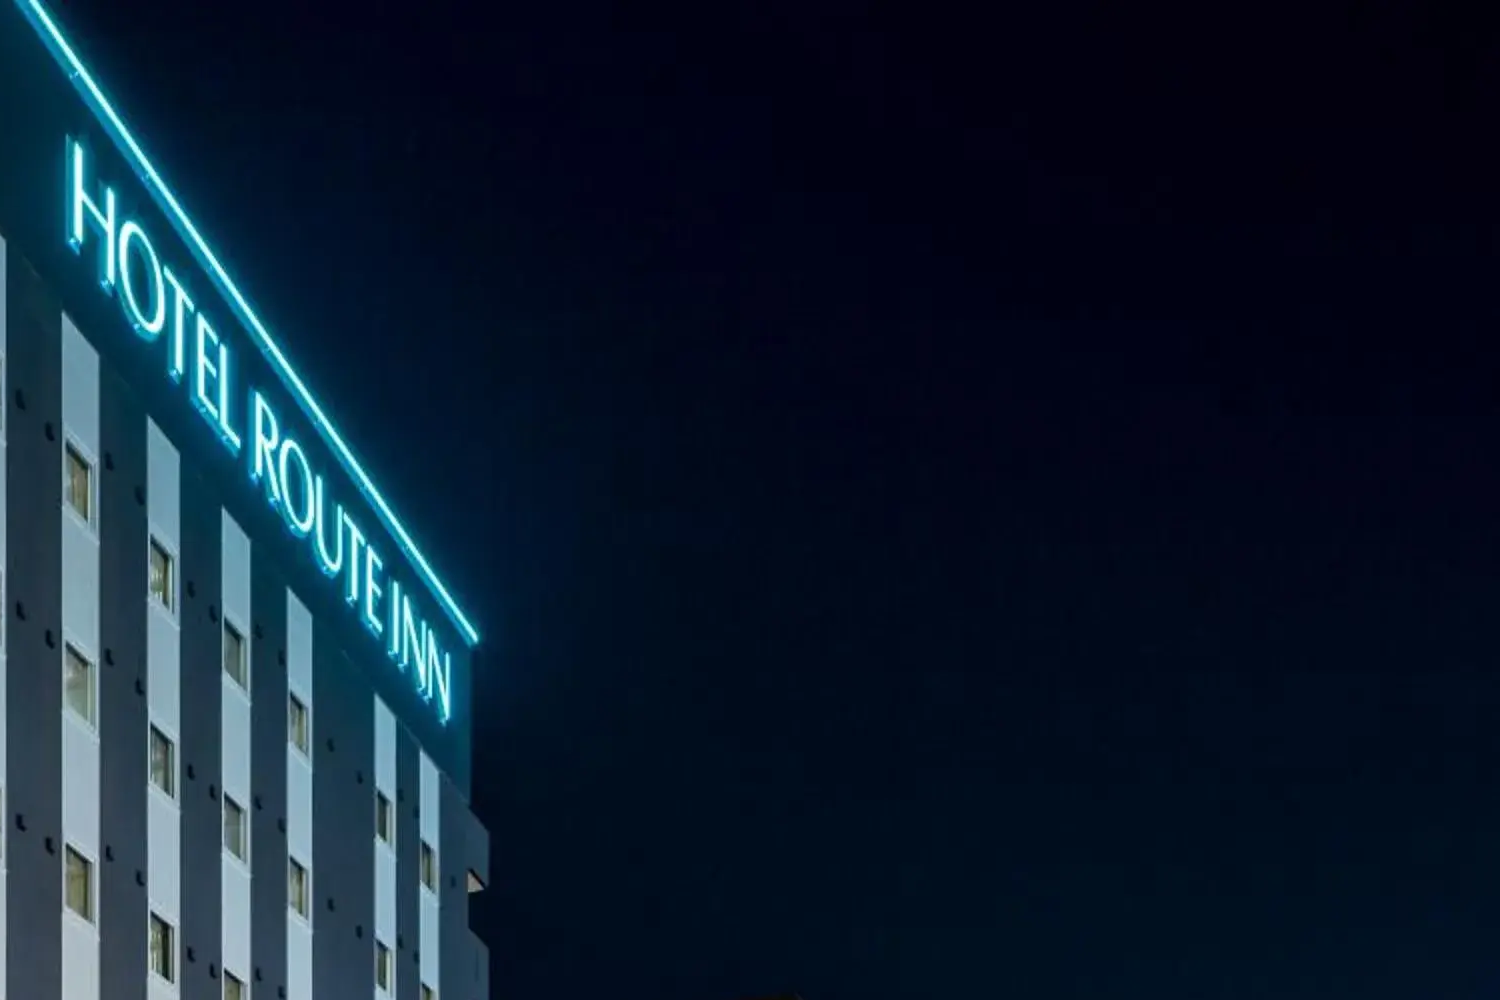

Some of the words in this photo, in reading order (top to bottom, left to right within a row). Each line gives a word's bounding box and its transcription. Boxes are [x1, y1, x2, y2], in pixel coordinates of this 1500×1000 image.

[67, 135, 241, 456] HOTEL
[250, 389, 385, 639] ROUTE
[387, 578, 452, 726] INN
